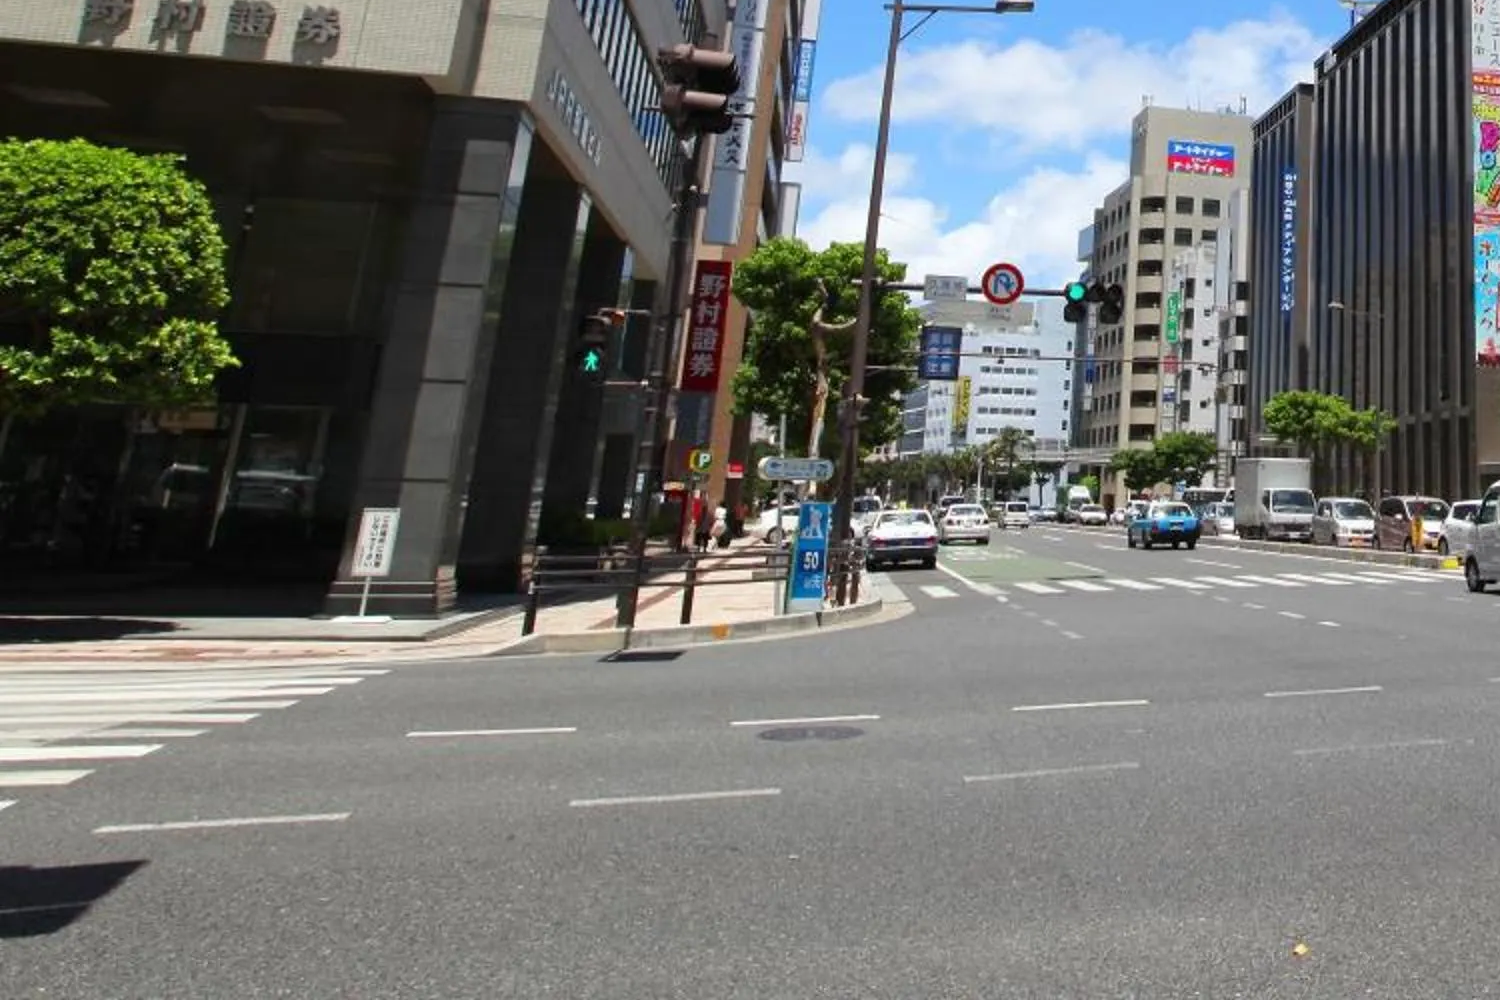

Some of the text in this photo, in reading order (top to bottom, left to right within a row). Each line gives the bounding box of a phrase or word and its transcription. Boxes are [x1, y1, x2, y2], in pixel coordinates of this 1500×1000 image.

[688, 273, 729, 378] 野村證券
[699, 452, 712, 468] P
[803, 551, 819, 570] 50
